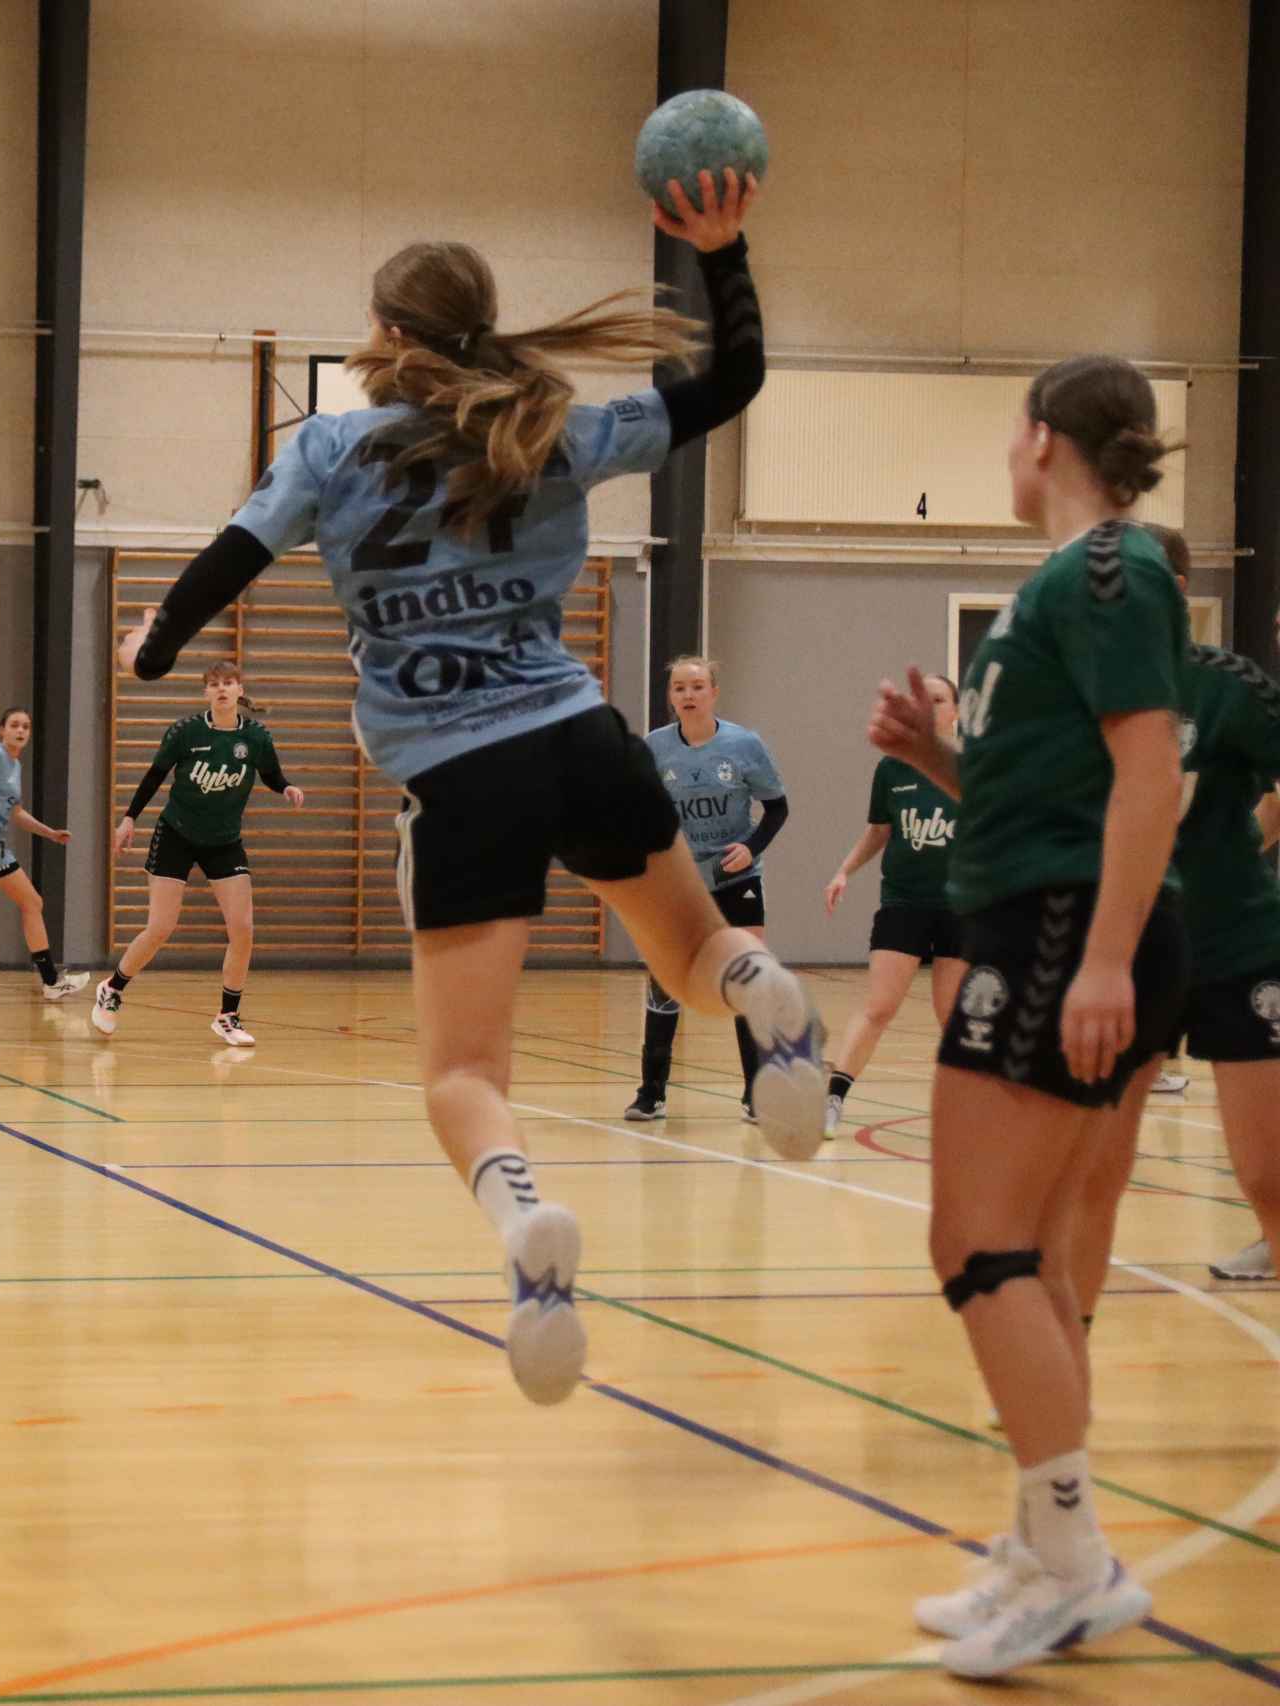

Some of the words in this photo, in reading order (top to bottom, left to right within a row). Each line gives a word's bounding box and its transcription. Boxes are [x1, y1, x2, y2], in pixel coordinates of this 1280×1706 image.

[916, 492, 927, 520] 4
[189, 760, 247, 793] Hybel
[900, 807, 956, 851] Hyb
